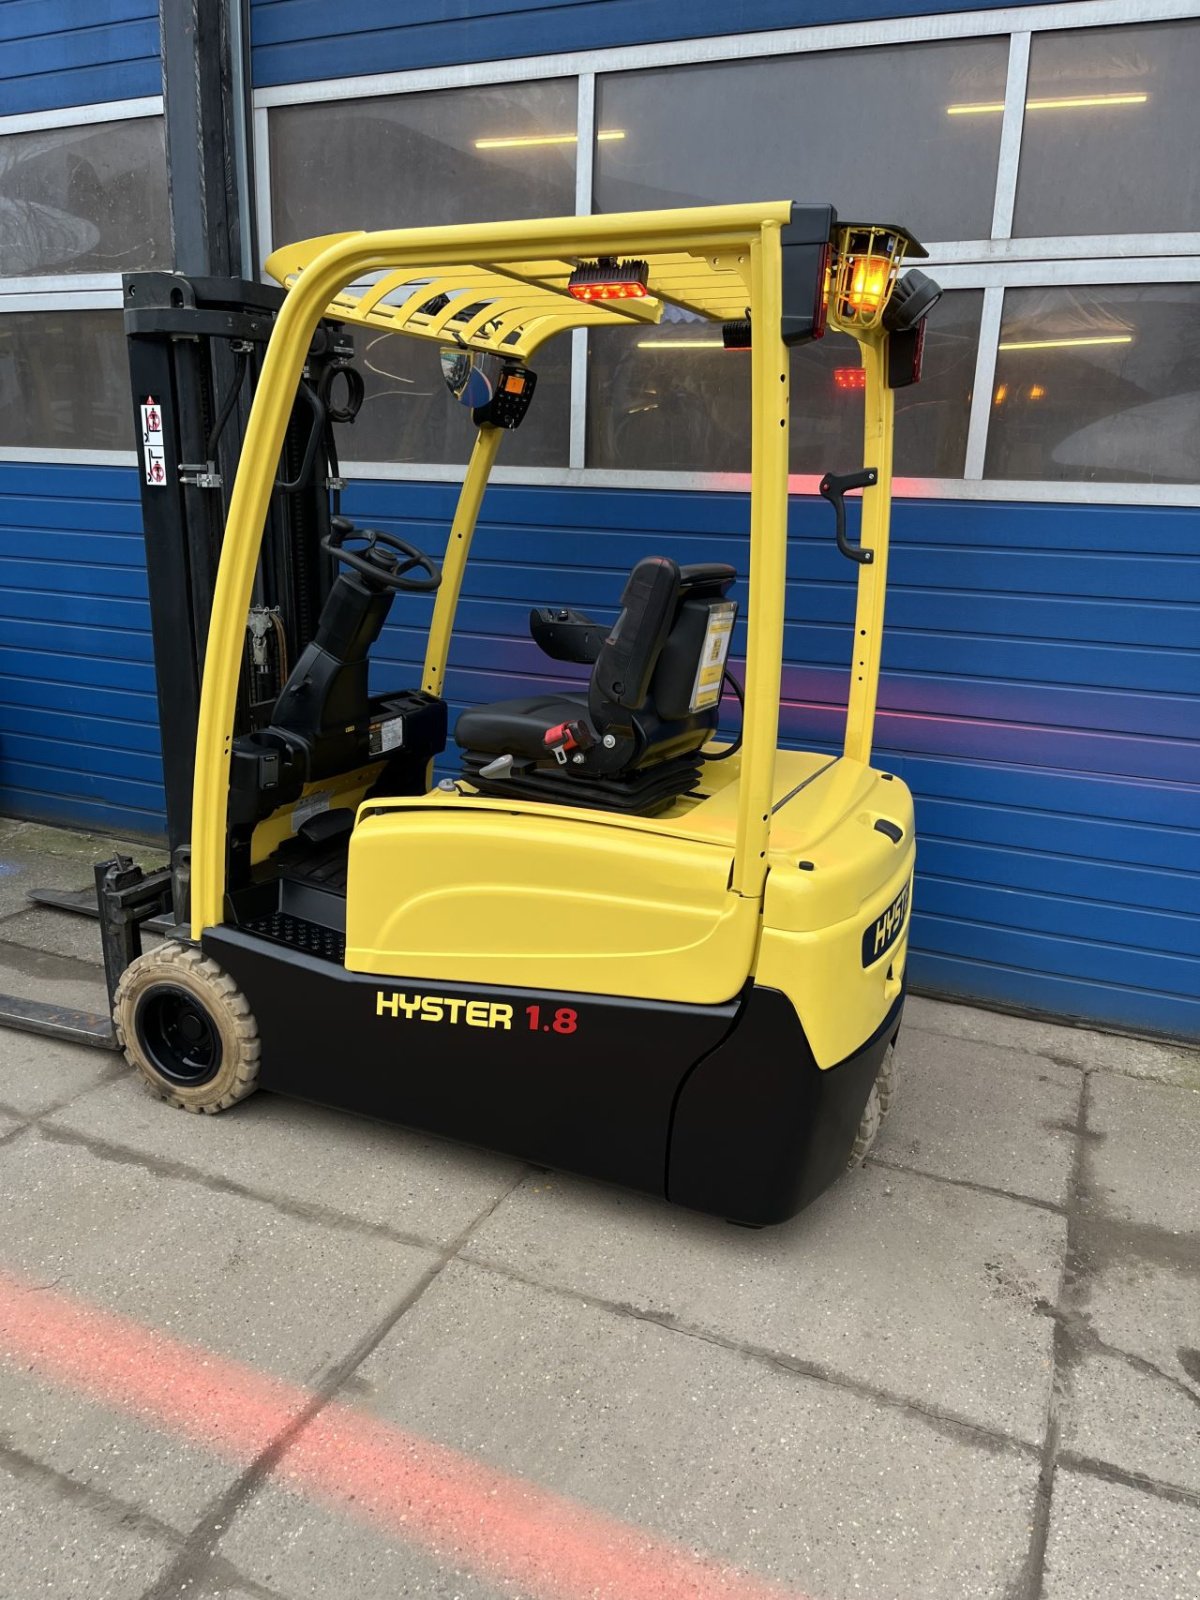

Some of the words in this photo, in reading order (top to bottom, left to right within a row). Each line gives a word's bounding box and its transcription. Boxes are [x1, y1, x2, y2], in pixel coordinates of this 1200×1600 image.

[873, 882, 909, 955] HYST
[376, 991, 514, 1030] HYSTER
[525, 1005, 578, 1034] 1.8
